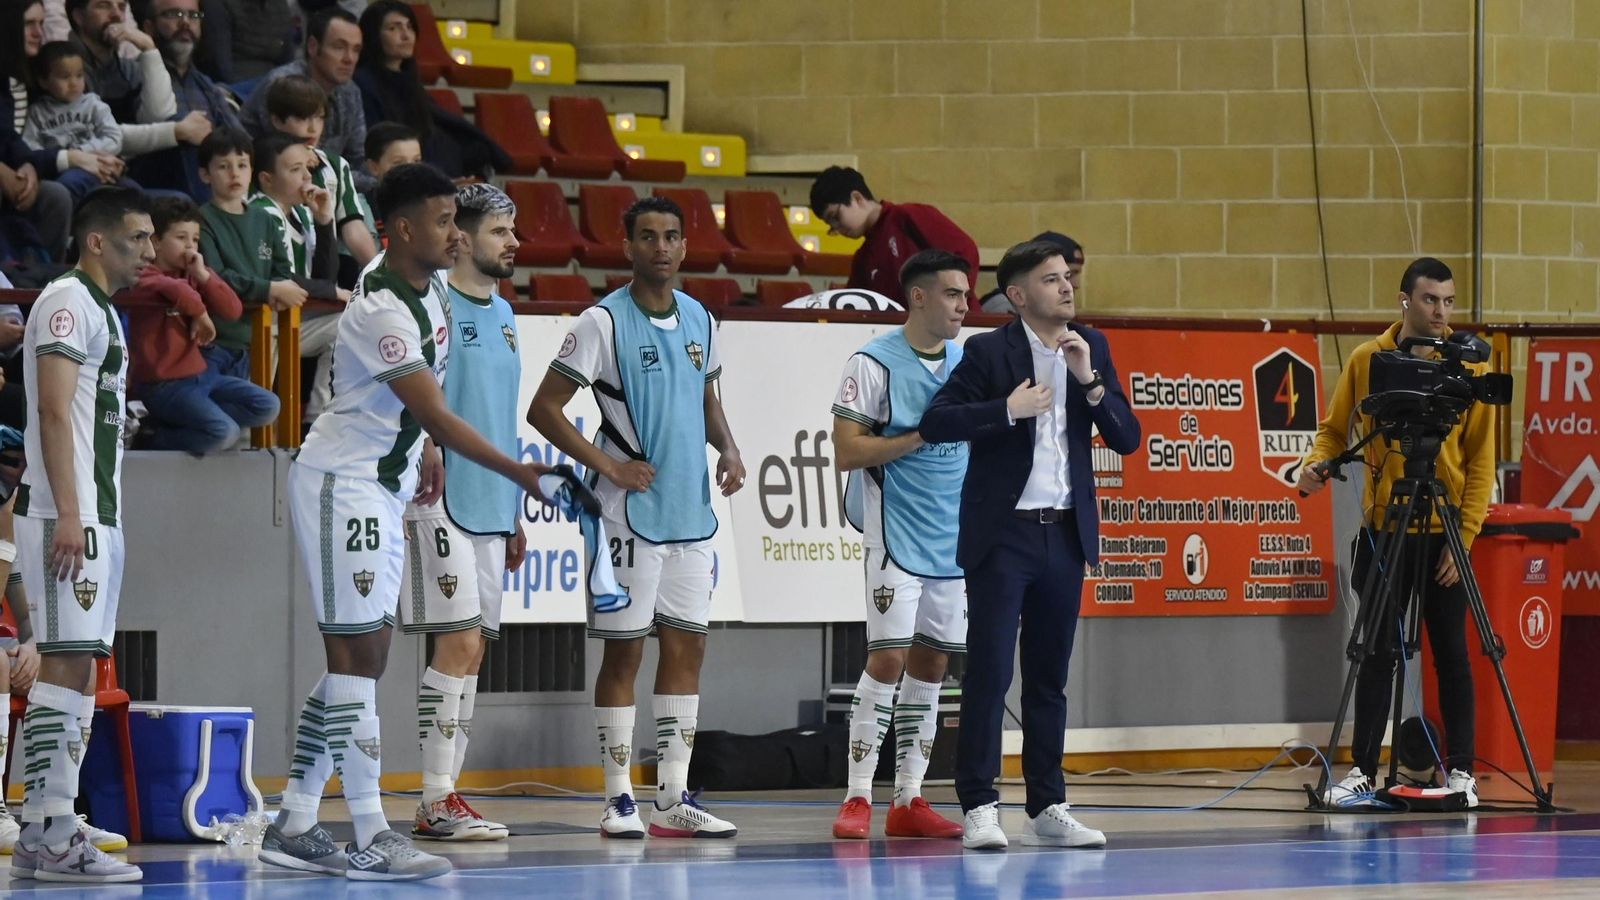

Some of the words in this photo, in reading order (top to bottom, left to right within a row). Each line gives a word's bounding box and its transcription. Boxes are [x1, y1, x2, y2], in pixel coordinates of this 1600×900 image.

[1131, 375, 1243, 409] Estaciones
[1180, 413, 1198, 433] de
[1527, 412, 1598, 435] Avda.
[1149, 437, 1233, 468] Servicio
[1264, 434, 1314, 452] RUTA
[1101, 498, 1134, 523] Mejor
[1137, 497, 1205, 522] Carburante
[1207, 498, 1219, 522] al
[1221, 497, 1255, 524] Mejor
[1258, 498, 1300, 524] precio.
[346, 517, 380, 552] 25
[434, 527, 451, 558] 6
[1100, 537, 1128, 554] Ramos
[1129, 536, 1167, 556] Bejarano
[1286, 536, 1304, 553] Ruta
[1304, 535, 1312, 553] 4
[610, 537, 635, 568] 21
[762, 536, 835, 561] Partners
[839, 536, 864, 561] be
[1148, 559, 1163, 578] 110
[1165, 589, 1194, 601] SERVICIO
[1244, 582, 1254, 600] La
[1255, 582, 1292, 602] Campana
